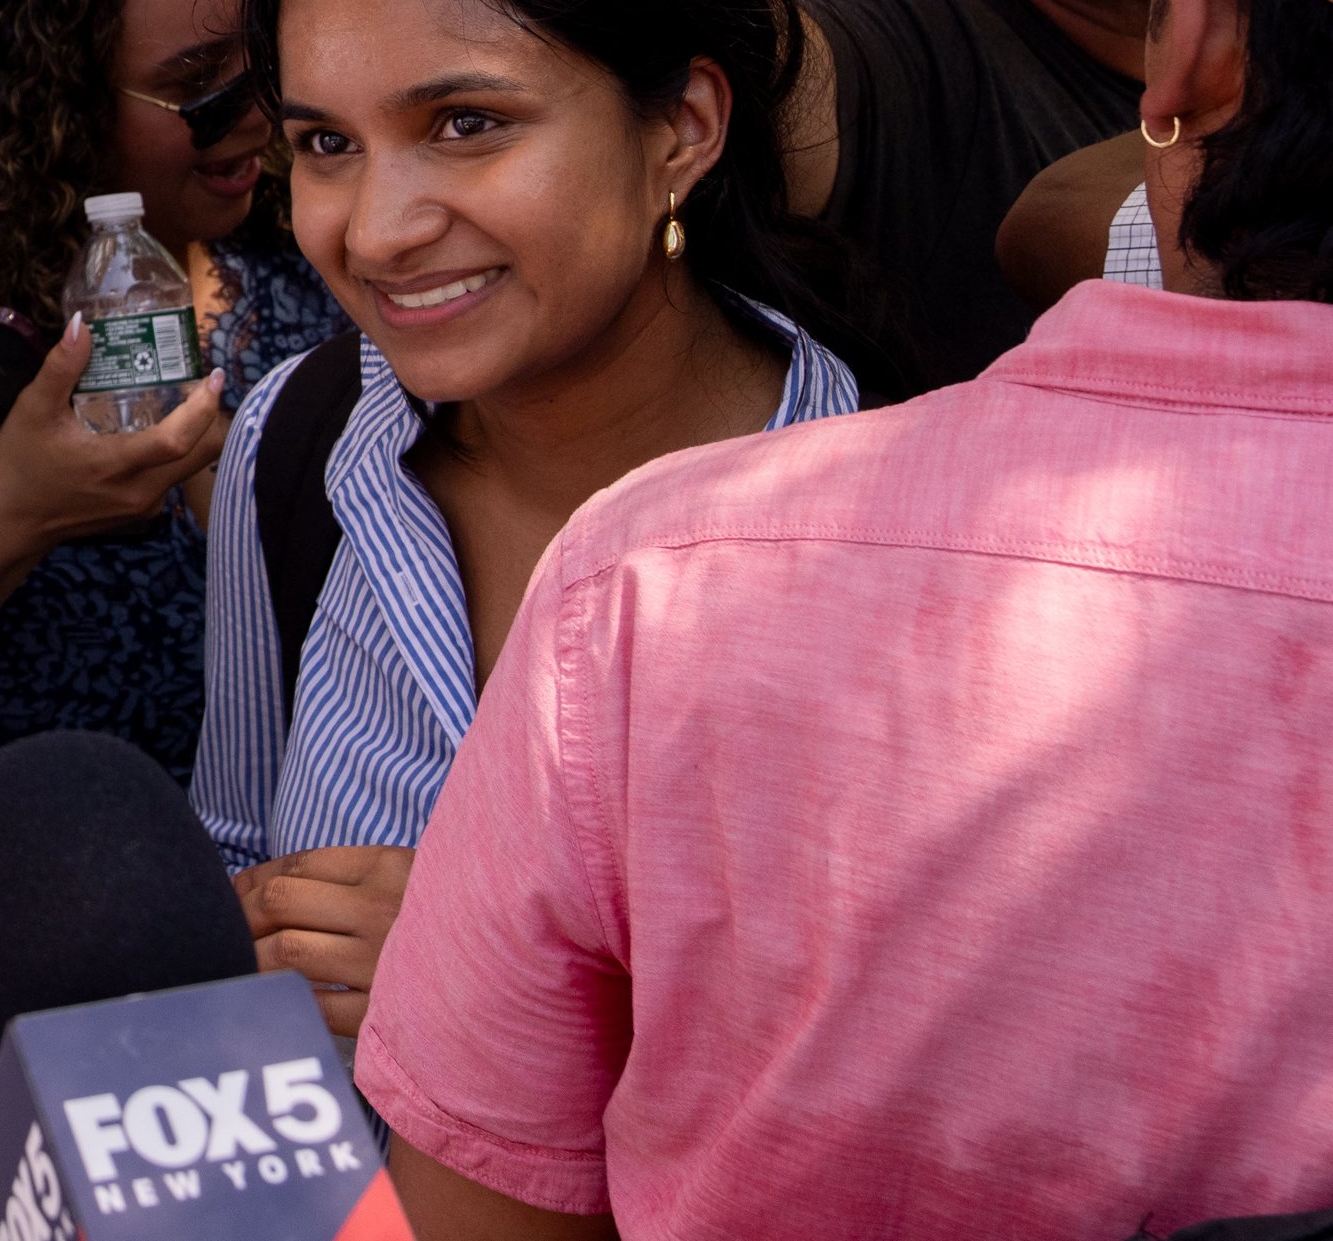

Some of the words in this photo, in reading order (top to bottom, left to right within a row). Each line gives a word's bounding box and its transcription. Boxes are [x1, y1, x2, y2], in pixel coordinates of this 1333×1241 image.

[63, 1069, 278, 1183] FOX
[262, 1057, 342, 1145] 5
[93, 1169, 202, 1215] NEW
[222, 1141, 362, 1190] YORK
